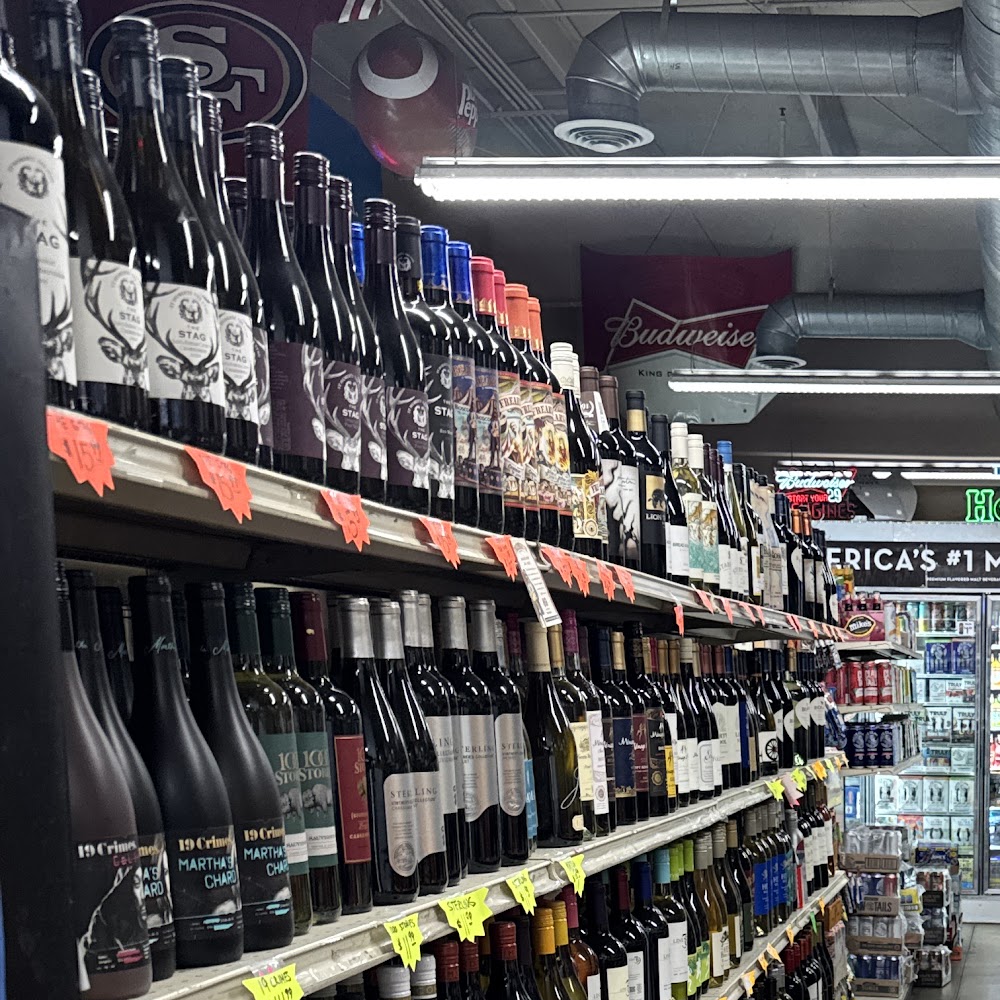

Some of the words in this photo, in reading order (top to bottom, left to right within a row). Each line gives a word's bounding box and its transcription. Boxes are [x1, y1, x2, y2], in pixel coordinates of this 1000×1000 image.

[119, 311, 141, 325] STAG
[178, 330, 207, 343] STAG
[605, 317, 757, 349] Budweise
[224, 352, 248, 364] STAG
[638, 369, 663, 378] KING
[775, 474, 856, 491] Budweiser
[827, 488, 842, 503] 29
[826, 548, 937, 572] ERICA'S
[946, 549, 973, 572] #1
[244, 829, 258, 842] 19
[259, 827, 285, 841] Crim
[78, 843, 95, 859] 19
[97, 839, 137, 855] Crimes
[178, 838, 195, 852] 19
[196, 835, 233, 850] Crimes
[178, 856, 234, 872] MARTHA'S
[266, 862, 288, 877] CHAR
[205, 870, 237, 890] CHARD
[874, 902, 892, 913] TAILS
[269, 971, 292, 988] CRIMES
